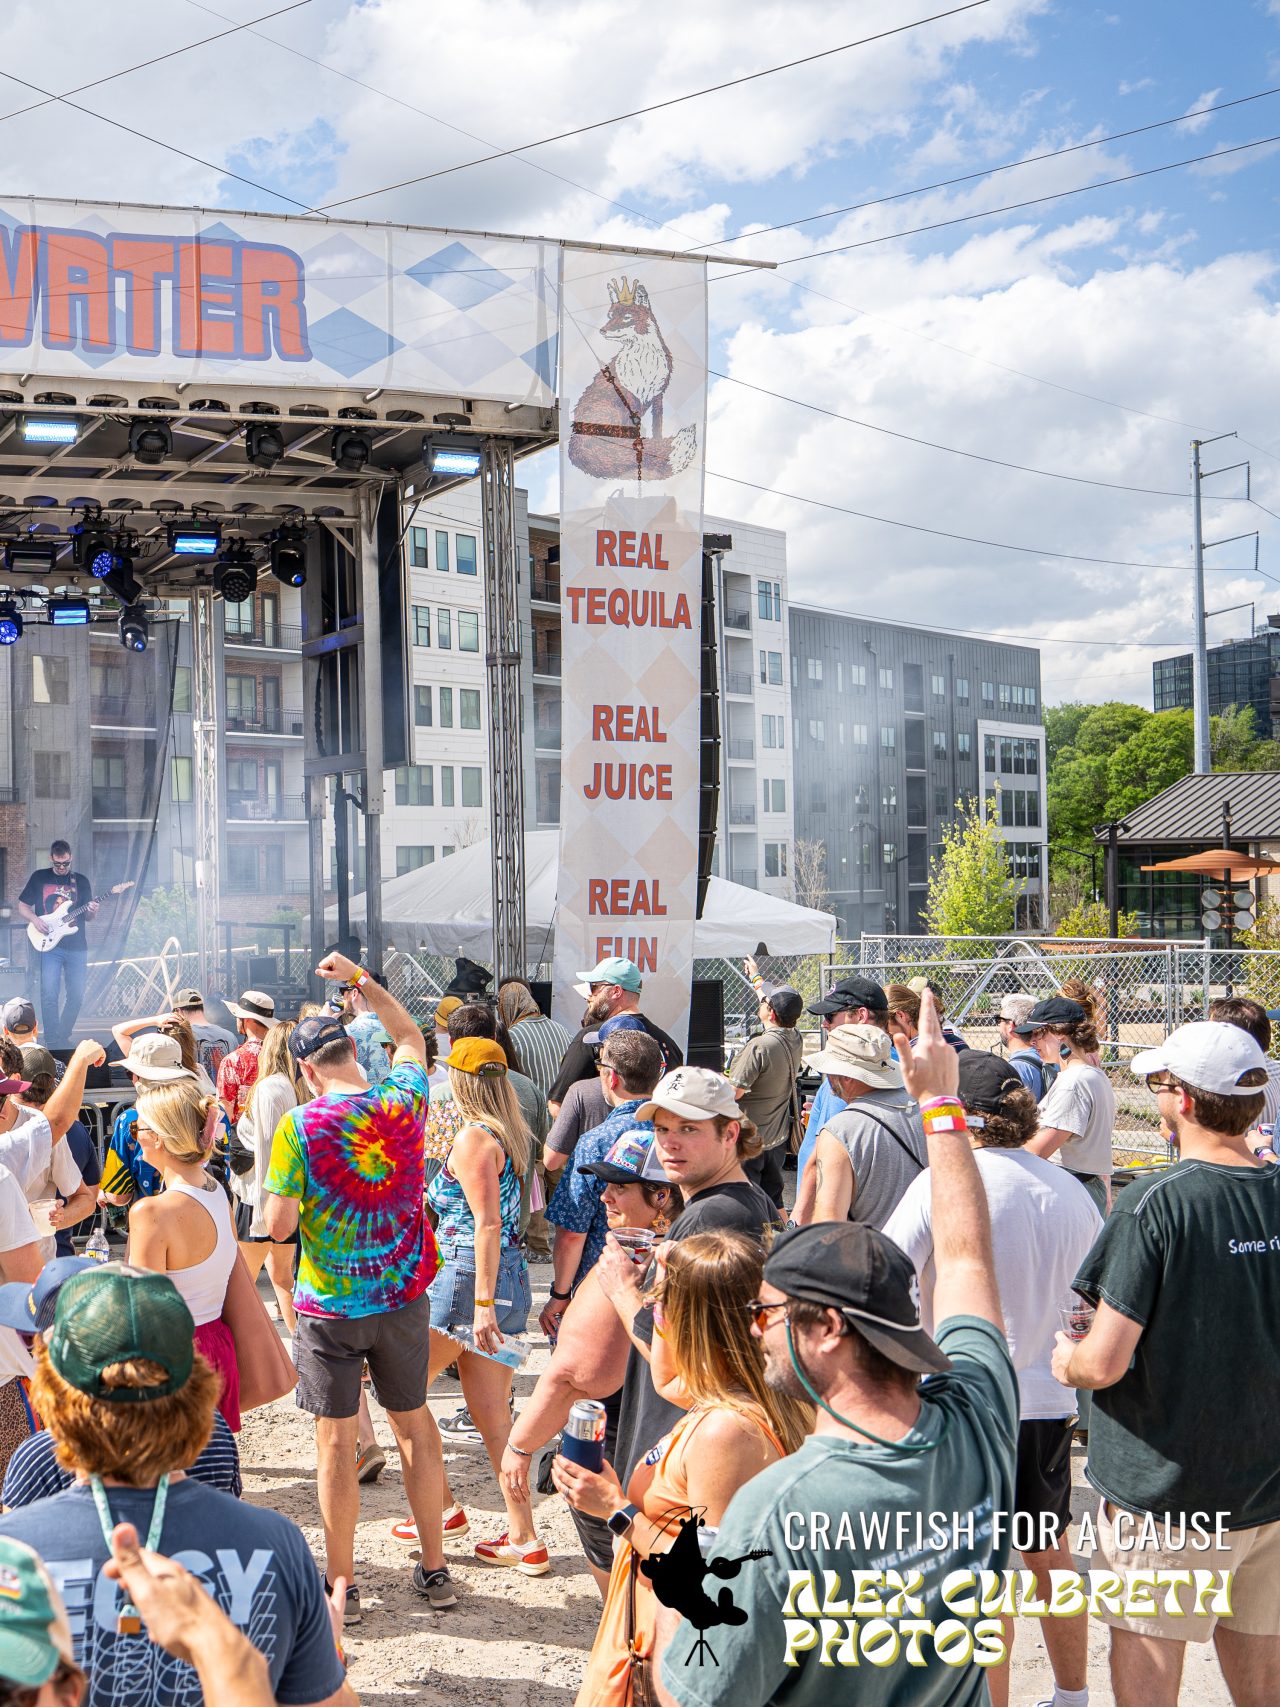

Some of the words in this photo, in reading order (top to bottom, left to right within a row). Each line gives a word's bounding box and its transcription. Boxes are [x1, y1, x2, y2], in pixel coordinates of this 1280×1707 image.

[596, 530, 669, 571] REAL
[567, 587, 692, 630] TEQUILA
[592, 704, 667, 743] REAL
[583, 762, 673, 801] JUICE
[588, 879, 667, 916] REAL
[596, 936, 657, 973] FUN
[1228, 1238, 1266, 1254] Some
